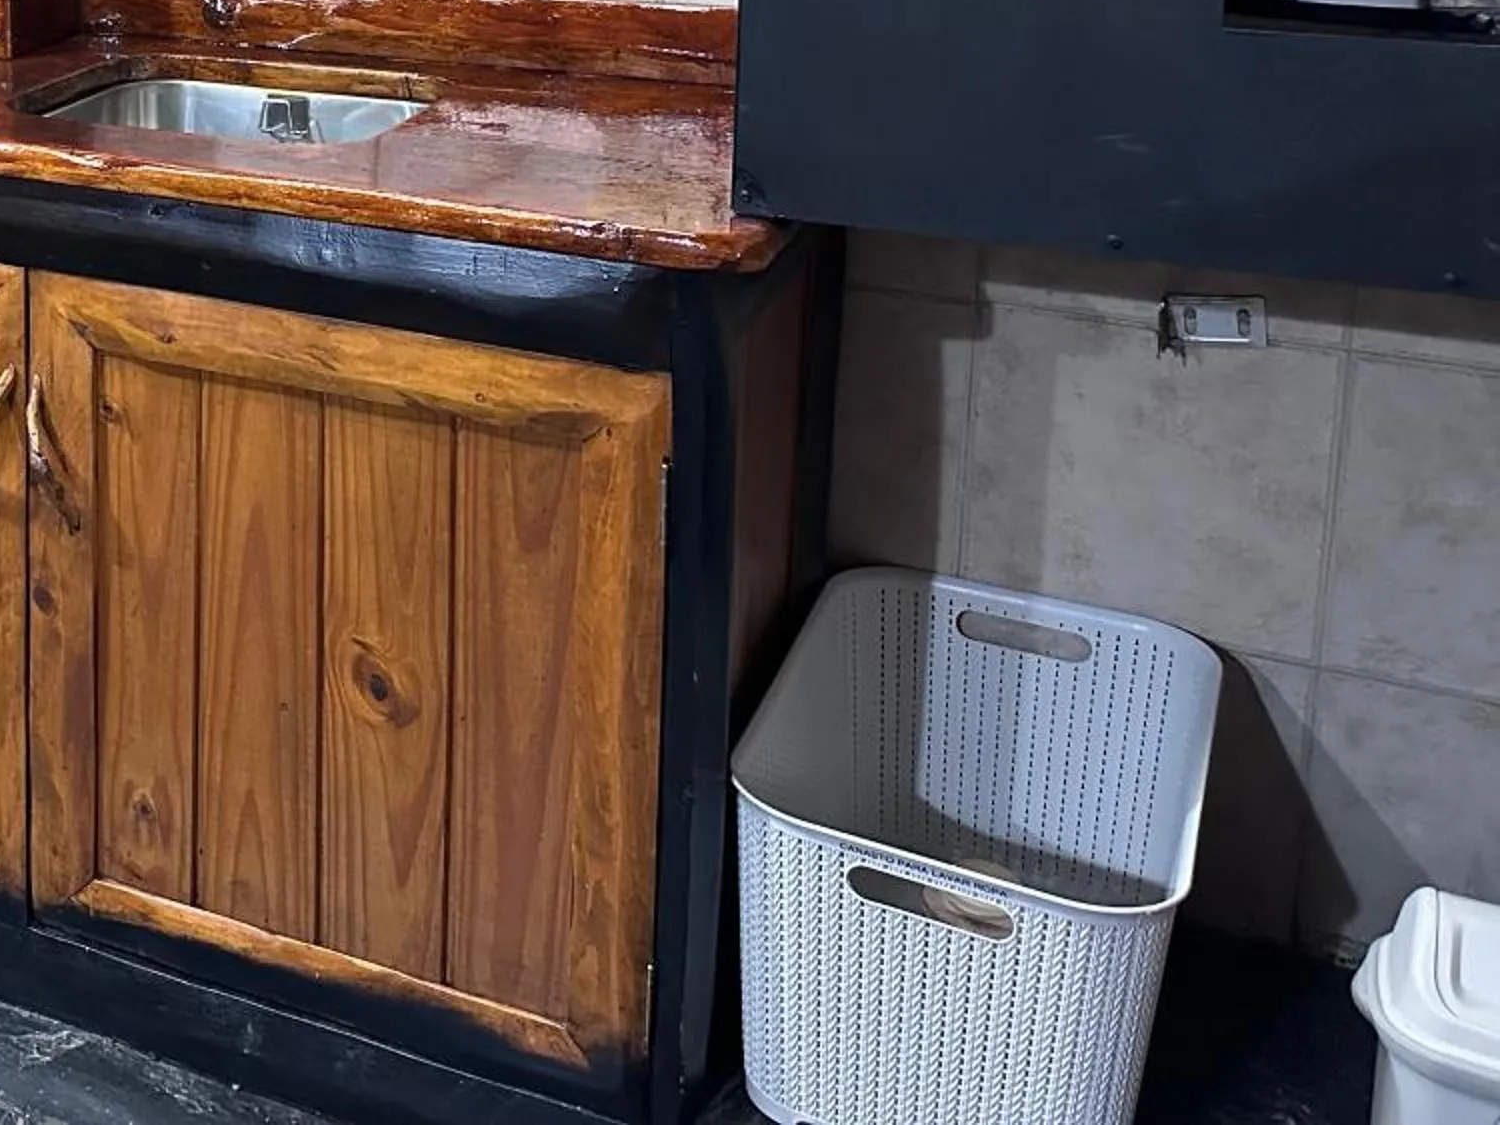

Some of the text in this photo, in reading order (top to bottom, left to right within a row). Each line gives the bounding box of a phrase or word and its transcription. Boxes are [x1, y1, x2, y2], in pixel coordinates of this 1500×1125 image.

[840, 841, 1008, 898] CANASTO PARA LAVAR ROPA
